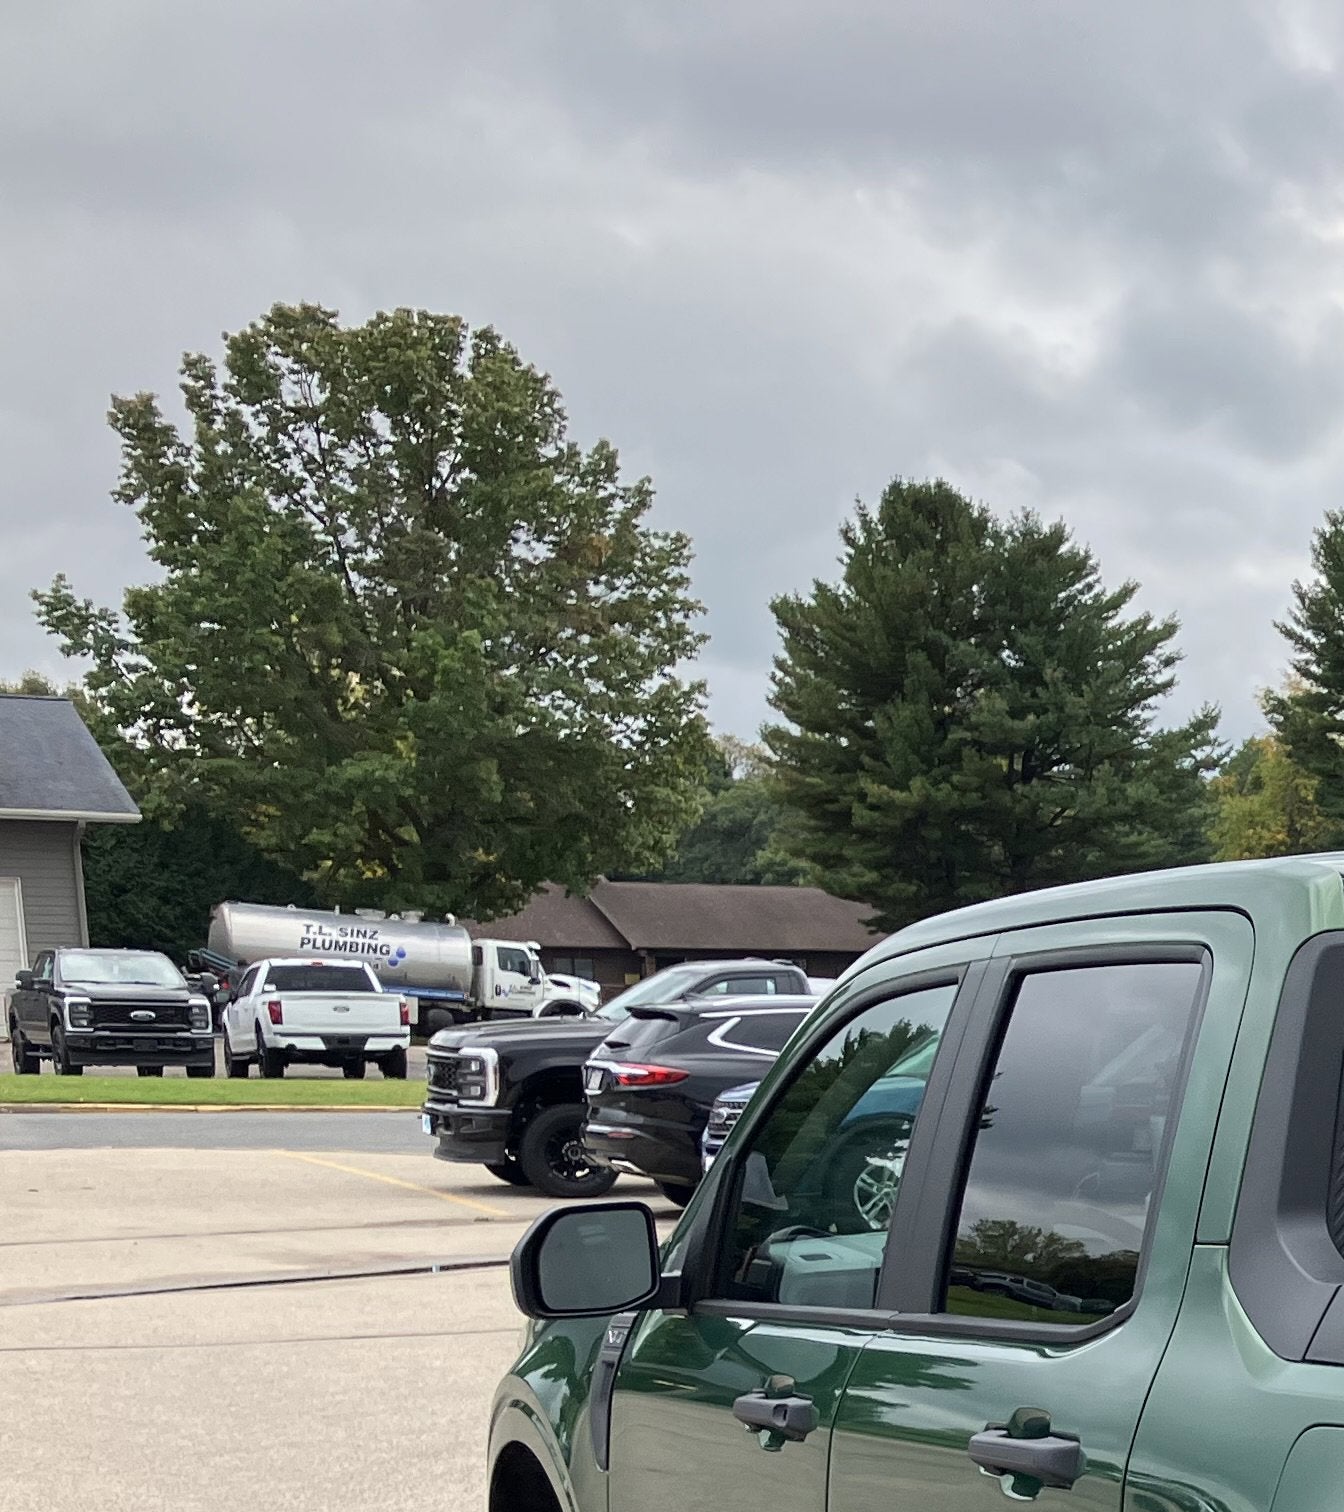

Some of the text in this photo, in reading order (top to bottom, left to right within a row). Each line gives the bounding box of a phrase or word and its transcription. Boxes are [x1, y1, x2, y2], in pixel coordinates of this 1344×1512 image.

[303, 923, 380, 941] T.L. SINZ
[299, 936, 391, 957] PLUMBING
